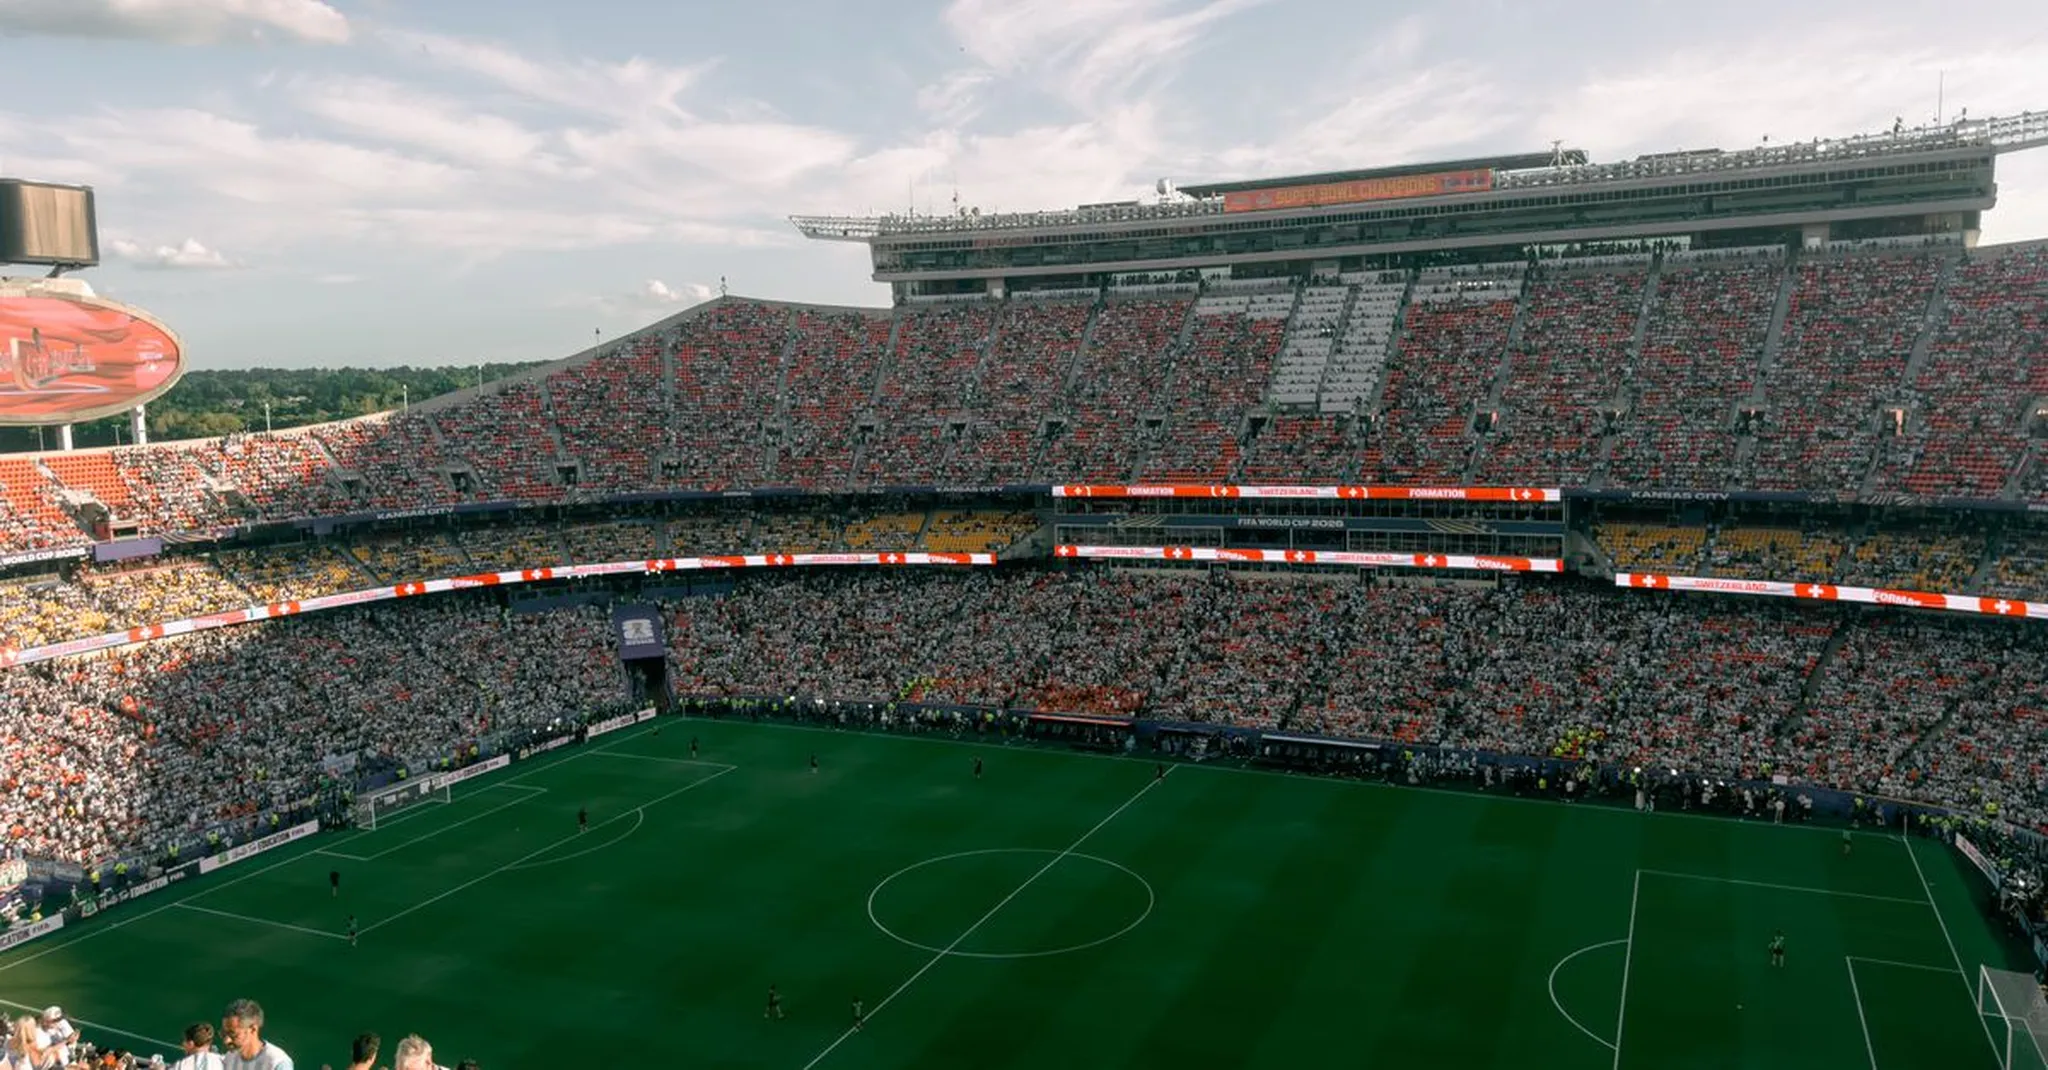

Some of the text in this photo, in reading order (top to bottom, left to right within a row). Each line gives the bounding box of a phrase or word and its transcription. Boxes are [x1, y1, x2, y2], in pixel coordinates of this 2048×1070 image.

[1275, 186, 1317, 206] SUPER
[1319, 184, 1355, 202] BOWL
[1359, 178, 1437, 199] CHAMPIONS
[976, 485, 1004, 493] CITY
[1126, 486, 1175, 496] FORMATION
[1258, 488, 1318, 497] SWITZERLAND
[1408, 488, 1466, 499] FORMATION
[1631, 491, 1730, 501] KANSAS CITY
[376, 506, 455, 520] KANSAS CITY
[1238, 518, 1257, 526] FIFA
[1258, 518, 1290, 527] WORLD
[1291, 519, 1311, 528] CUP
[2, 554, 36, 566] WORLD
[36, 551, 54, 561] CUP
[1693, 579, 1768, 592] SWITZERLAND
